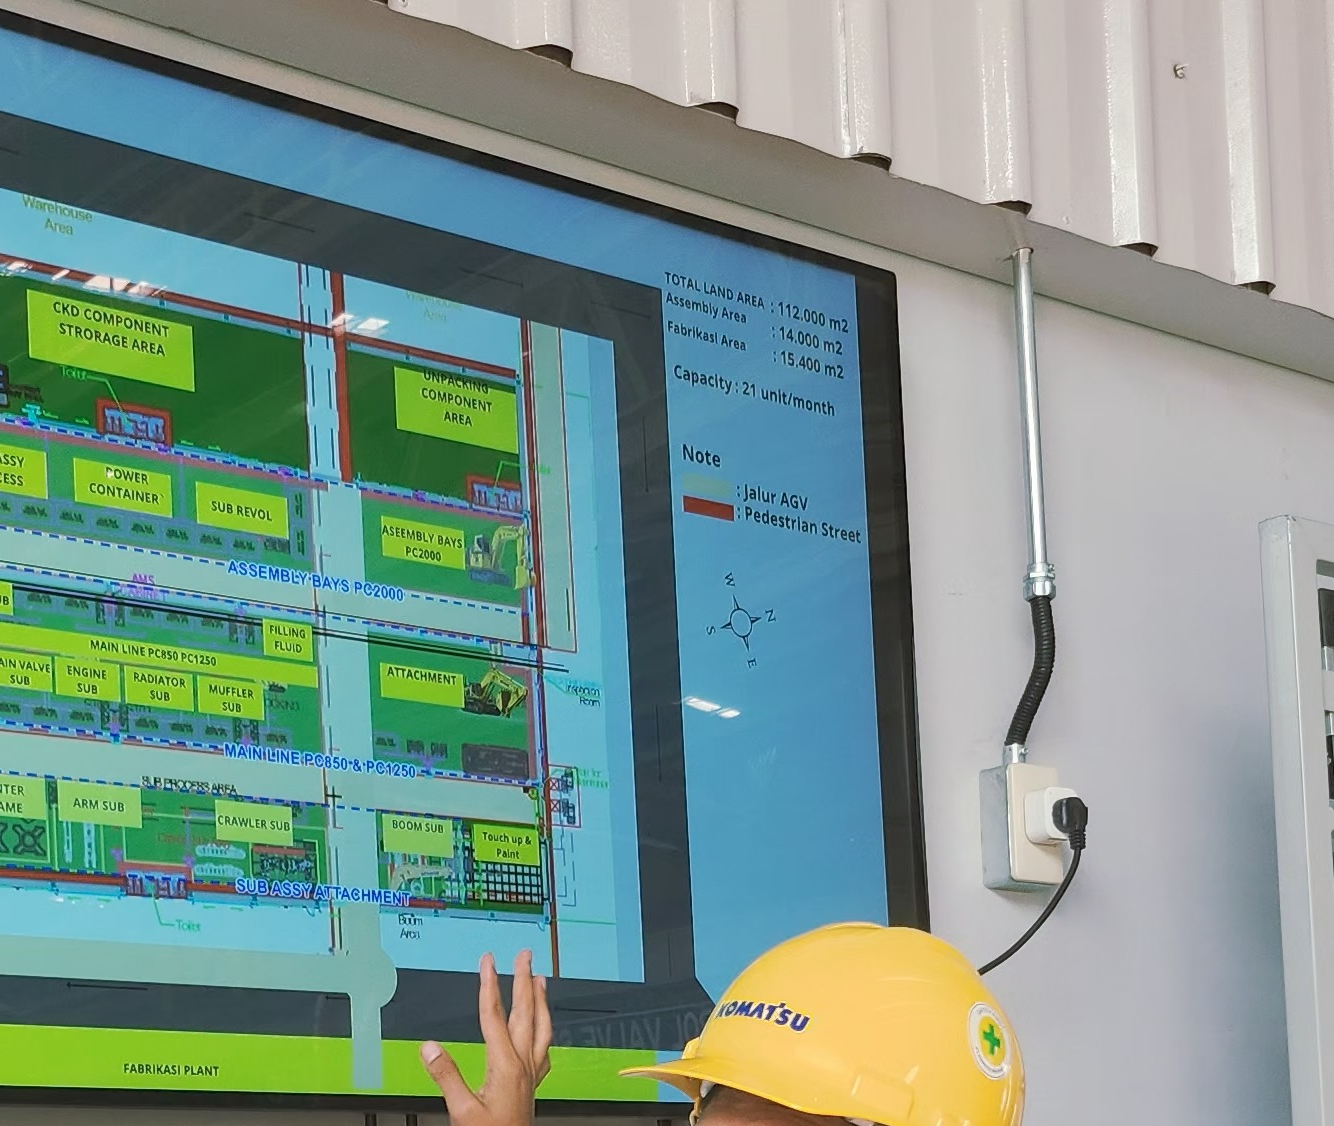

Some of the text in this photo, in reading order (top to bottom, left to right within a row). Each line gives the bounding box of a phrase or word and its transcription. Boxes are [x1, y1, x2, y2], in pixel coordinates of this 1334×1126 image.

[45, 218, 73, 235] Area
[665, 272, 701, 292] TOTAL
[704, 282, 734, 301] LAND
[737, 291, 765, 309] AREA
[778, 302, 826, 327] 112.000
[829, 317, 849, 333] m2
[53, 301, 169, 339] CKD COMPONENT
[666, 292, 719, 319] Assembly
[721, 308, 747, 324] Area
[779, 327, 819, 349] 14.000
[823, 338, 843, 355] m2
[59, 322, 166, 357] STRORAGE AREA
[667, 320, 718, 345] Fabrikasi
[721, 335, 747, 351] Area
[780, 350, 821, 373] 15.400
[824, 363, 844, 379] m2
[423, 369, 489, 394] UNPACKING
[673, 364, 732, 395] Capacity
[742, 381, 757, 398] 21
[761, 387, 835, 417] unit/month
[421, 387, 492, 412] COMPONENT
[443, 410, 473, 427] AREA
[682, 444, 721, 467] Note
[105, 466, 149, 485] POWER
[743, 484, 776, 505] Jalur
[780, 492, 808, 511] AGV
[211, 500, 272, 522] SUB REVOL
[744, 506, 817, 535] Pedestrian
[821, 522, 862, 544] Street
[382, 525, 463, 549] ASEEMBLY BAYS
[406, 546, 441, 562] PC2000
[227, 561, 404, 602] ASSEMBLY BAYS PC2000
[725, 572, 736, 588] W
[765, 609, 776, 623] N
[269, 625, 306, 640] FILLING
[706, 625, 716, 636] S
[89, 639, 216, 666] MAIN LINE PC850 PC1250
[274, 640, 302, 654] FLUID
[19, 659, 51, 673] VALVE
[747, 658, 757, 669] E
[10, 674, 30, 686] SUB
[67, 665, 107, 680] ENGINE
[133, 672, 186, 688] RADIATOR
[387, 666, 457, 686] ATTACHMENT
[77, 683, 98, 695] SUB
[150, 690, 170, 702] SUB
[209, 684, 254, 700] MUFFLER
[222, 701, 242, 713] SUB
[224, 743, 267, 761] MAIN
[268, 747, 300, 765] LINE
[304, 752, 347, 770] PC850
[366, 760, 416, 778] PC1250
[73, 798, 125, 812] ARM SUB
[217, 814, 290, 832] CRAWLER SUB
[392, 819, 444, 834] BOOM SUB
[482, 831, 532, 847] Touch up &
[496, 848, 519, 860] Paint
[236, 878, 410, 907] SUB ASSY ATTACHMENT
[715, 1000, 810, 1032] KOMATSU
[123, 1063, 219, 1076] FABRIKASI PLANT
